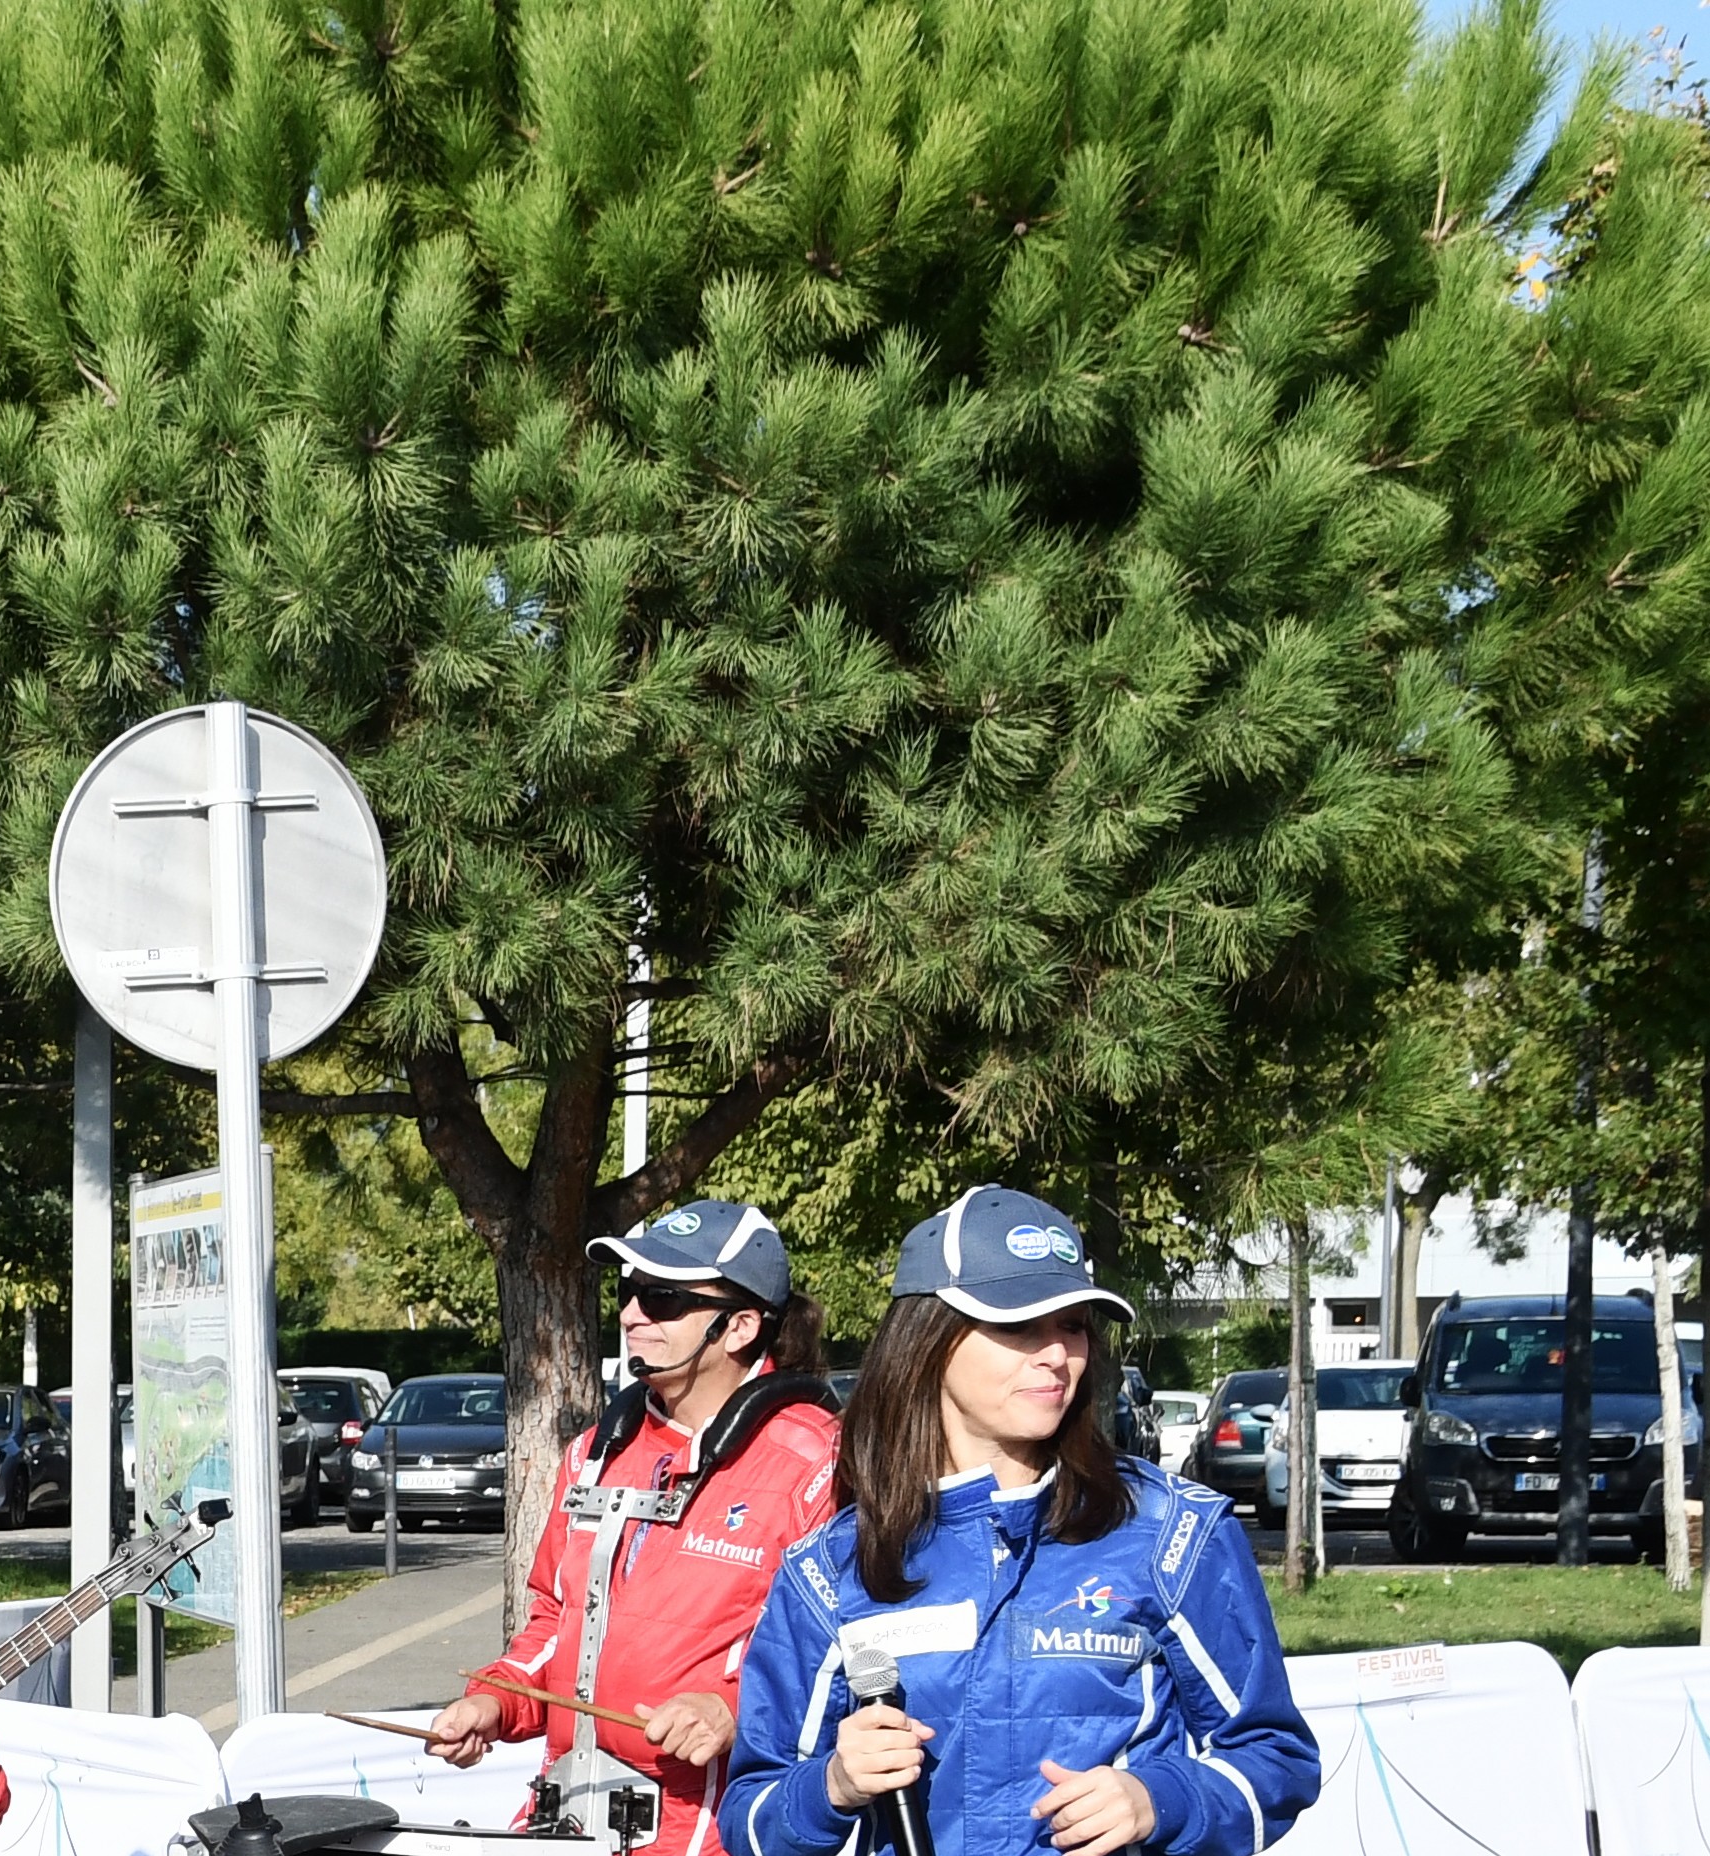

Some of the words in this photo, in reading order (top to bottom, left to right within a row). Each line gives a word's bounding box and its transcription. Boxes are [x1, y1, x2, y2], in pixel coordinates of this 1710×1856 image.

[682, 1529, 765, 1567] Matmut
[1161, 1510, 1199, 1574] sparco
[1032, 1627, 1142, 1656] Matmut
[1357, 1648, 1444, 1673] FESTIVAL
